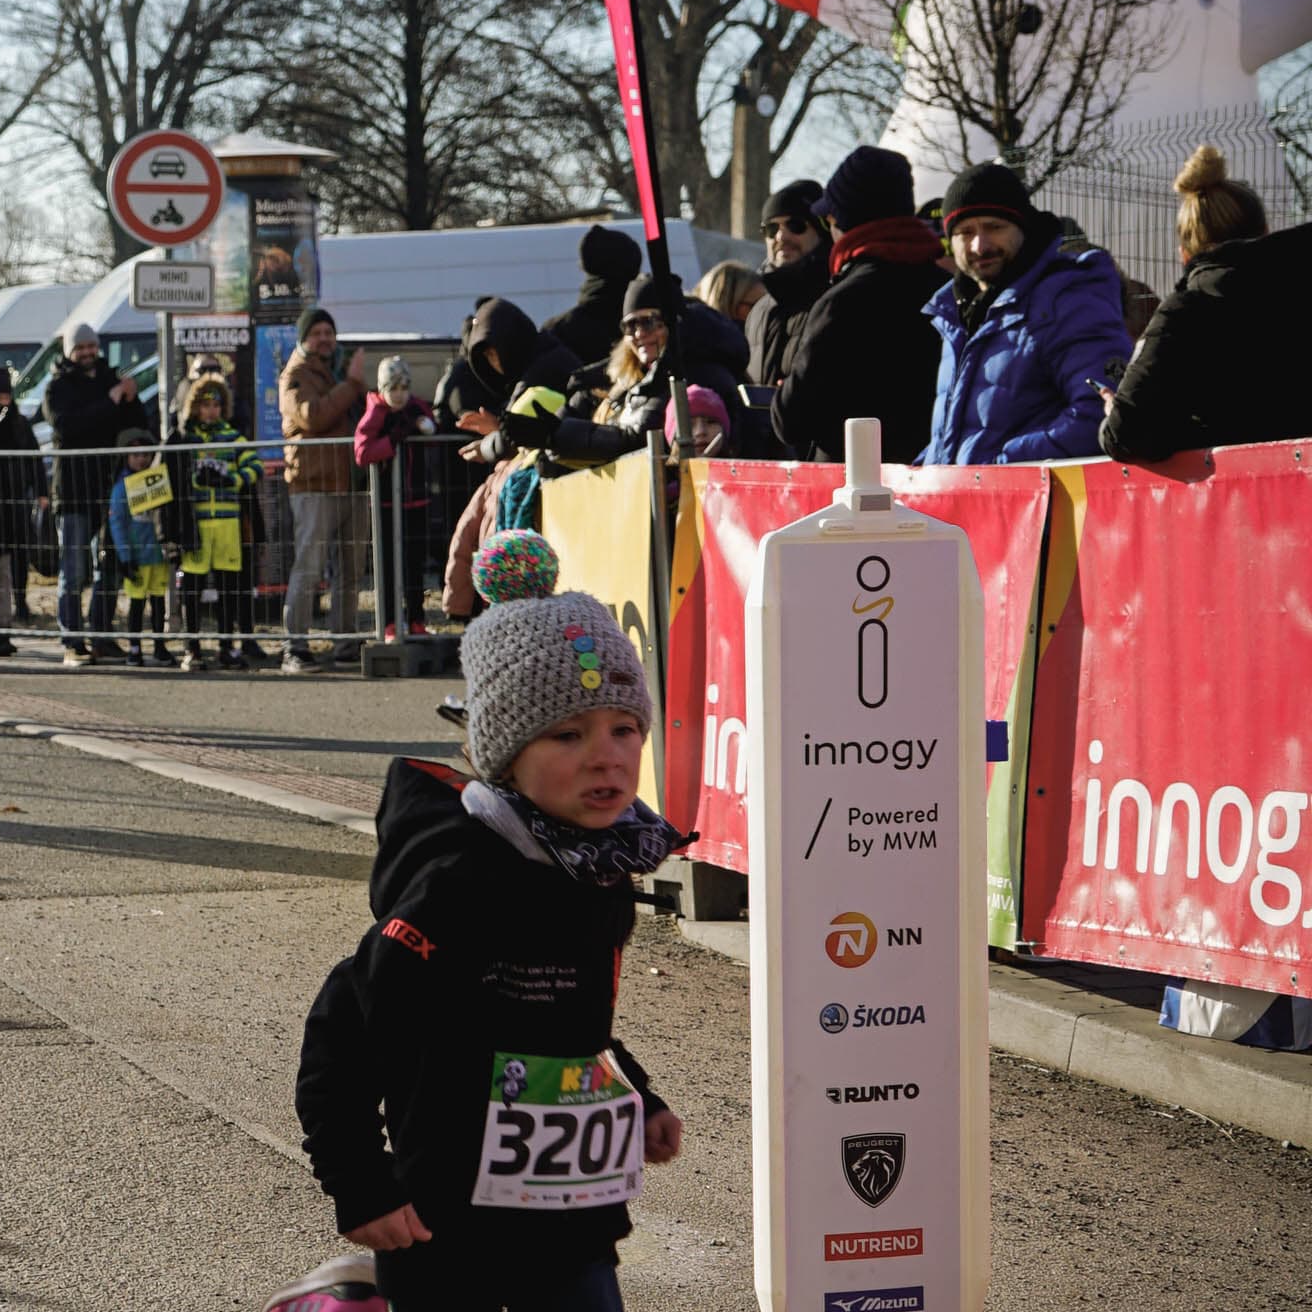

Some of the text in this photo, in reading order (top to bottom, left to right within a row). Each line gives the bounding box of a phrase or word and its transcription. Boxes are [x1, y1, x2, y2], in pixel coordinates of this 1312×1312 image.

[804, 733, 938, 770] innogy
[848, 802, 939, 826] Powered
[848, 830, 937, 857] by MVM
[1082, 740, 1312, 928] innog
[887, 927, 922, 947] NN
[852, 1005, 926, 1028] ŠKODA
[844, 1083, 920, 1104] RUNTO
[489, 1102, 637, 1176] 3207
[848, 1138, 899, 1149] PEUGEOT
[830, 1235, 919, 1255] NUTREND
